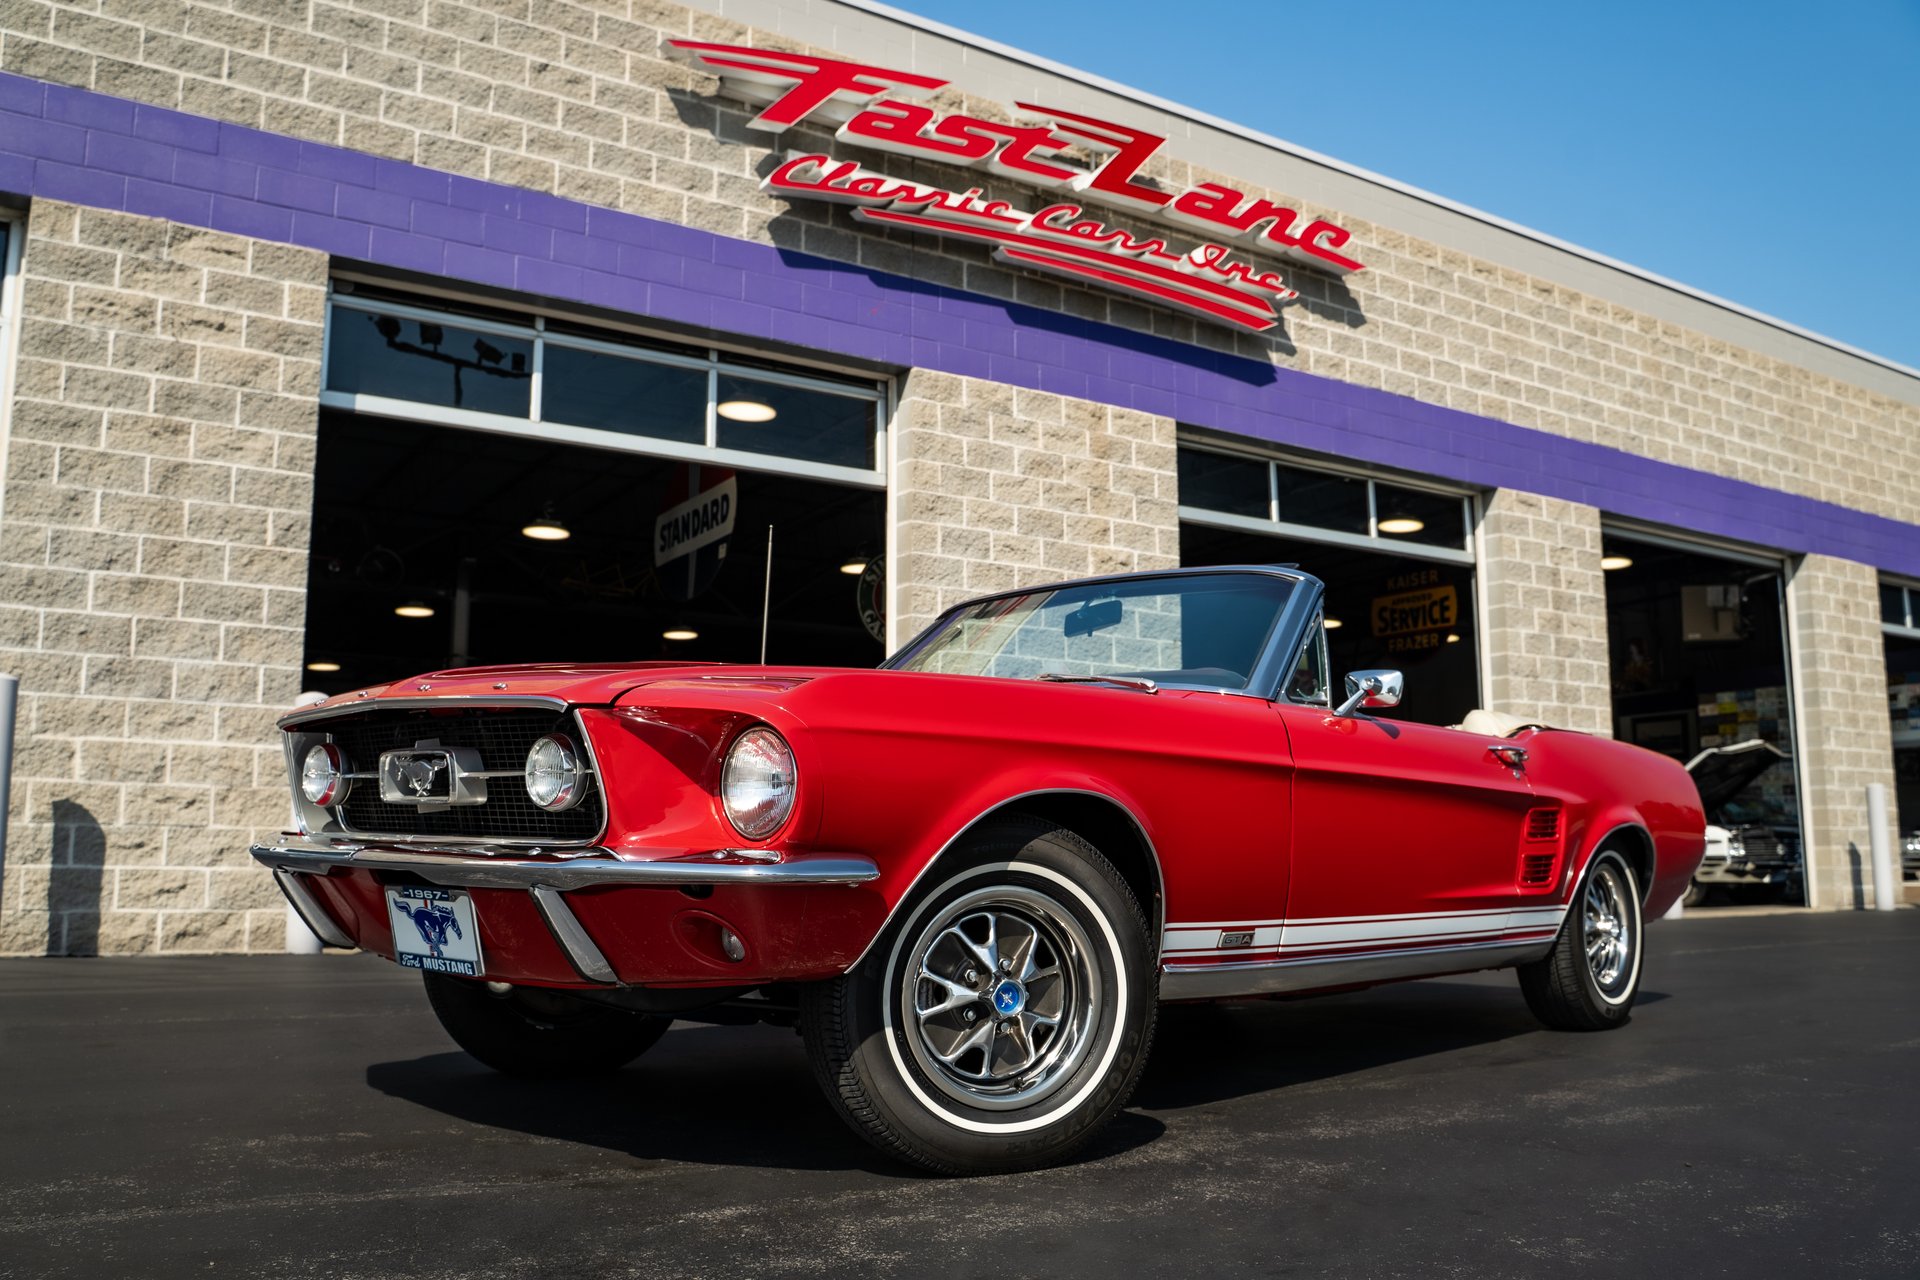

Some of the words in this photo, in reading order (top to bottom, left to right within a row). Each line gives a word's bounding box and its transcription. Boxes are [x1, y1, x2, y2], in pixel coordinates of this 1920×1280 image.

[667, 39, 1085, 182] Fast
[1014, 101, 1366, 272] Lane
[766, 153, 1028, 226] Classic
[1030, 204, 1184, 263] Cars
[659, 493, 730, 553] STANDARD
[1386, 569, 1439, 591] KAISER
[1378, 596, 1450, 632] SERVICE
[1386, 632, 1439, 654] FRAZER
[402, 954, 421, 968] Ford
[422, 957, 473, 975] MUSTANG
